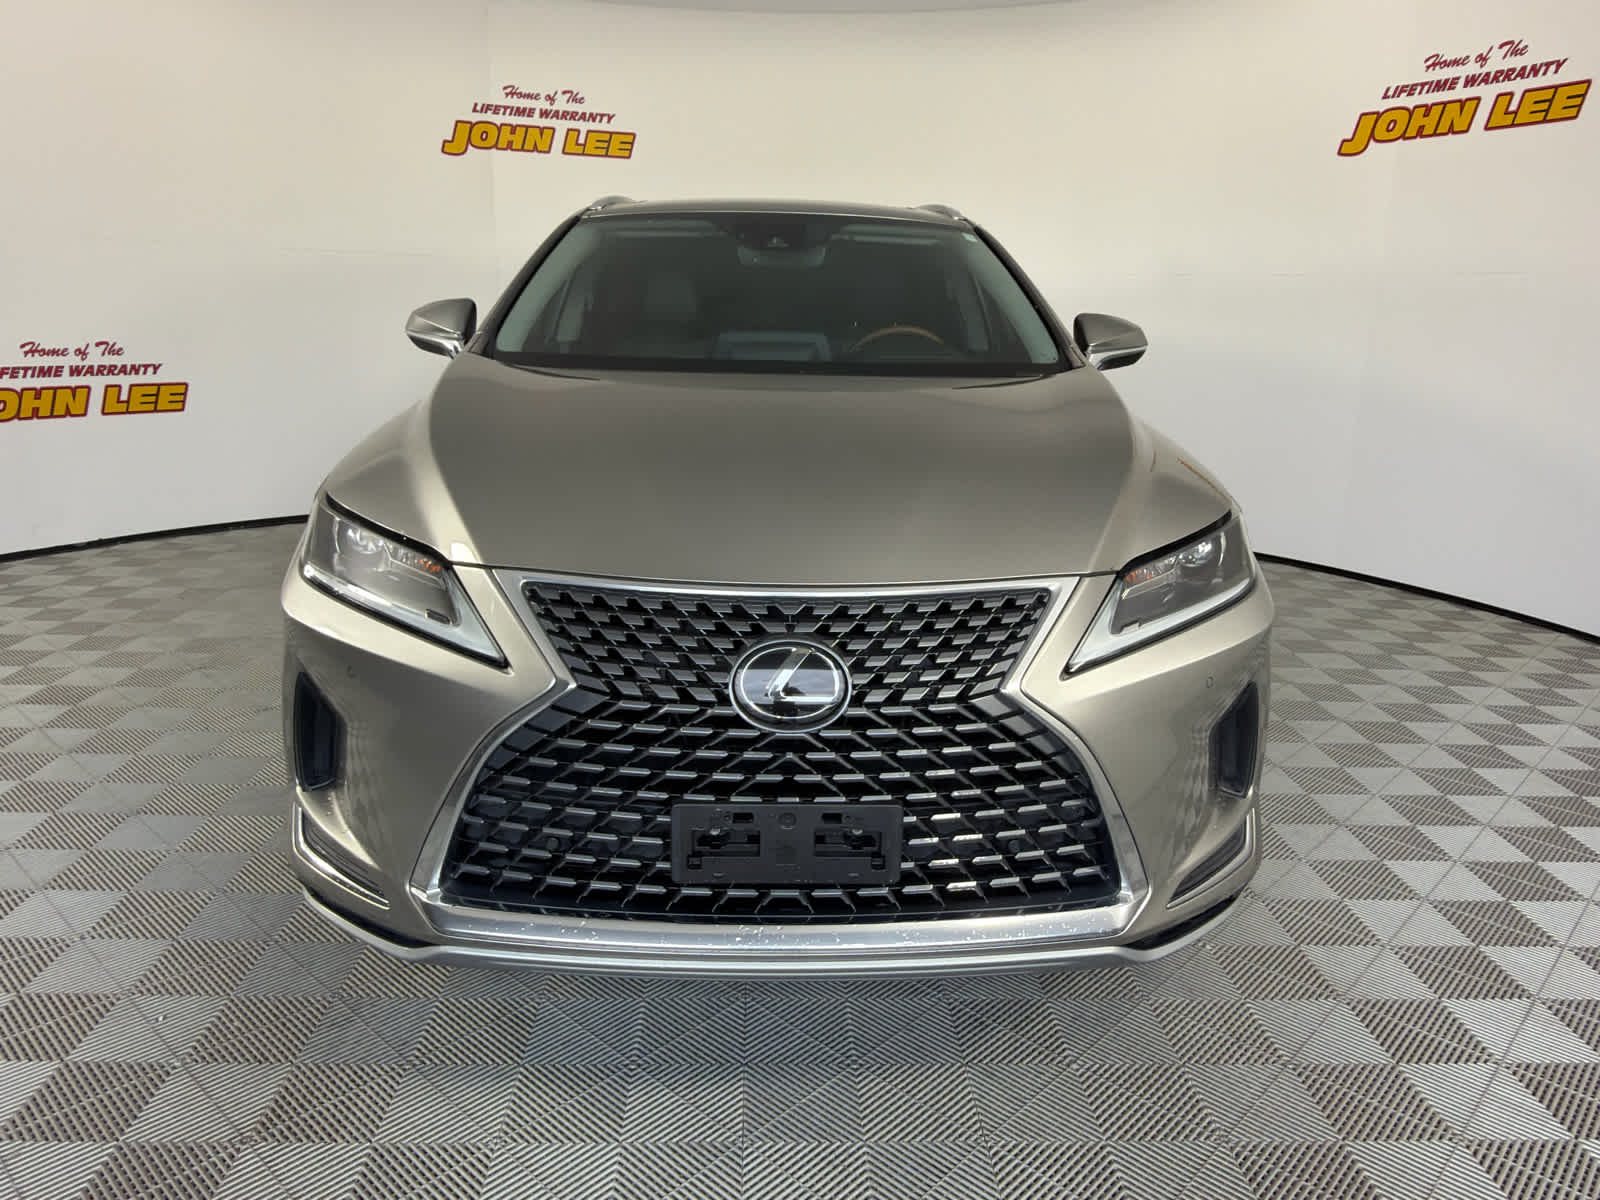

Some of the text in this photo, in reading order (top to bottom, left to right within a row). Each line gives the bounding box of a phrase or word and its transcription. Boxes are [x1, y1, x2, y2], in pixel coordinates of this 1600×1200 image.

[1424, 39, 1529, 72] Home of The
[502, 85, 585, 106] Home of The
[1381, 58, 1568, 100] LIFETIME WARRANTY
[472, 103, 616, 124] LIFETIME WARRANTY
[1337, 79, 1592, 157] JOHN LEE
[441, 120, 636, 159] JOHN LEE
[19, 341, 125, 361] Home of The
[0, 363, 162, 379] FETIME WARRANTY
[0, 382, 189, 422] OHN LEE
